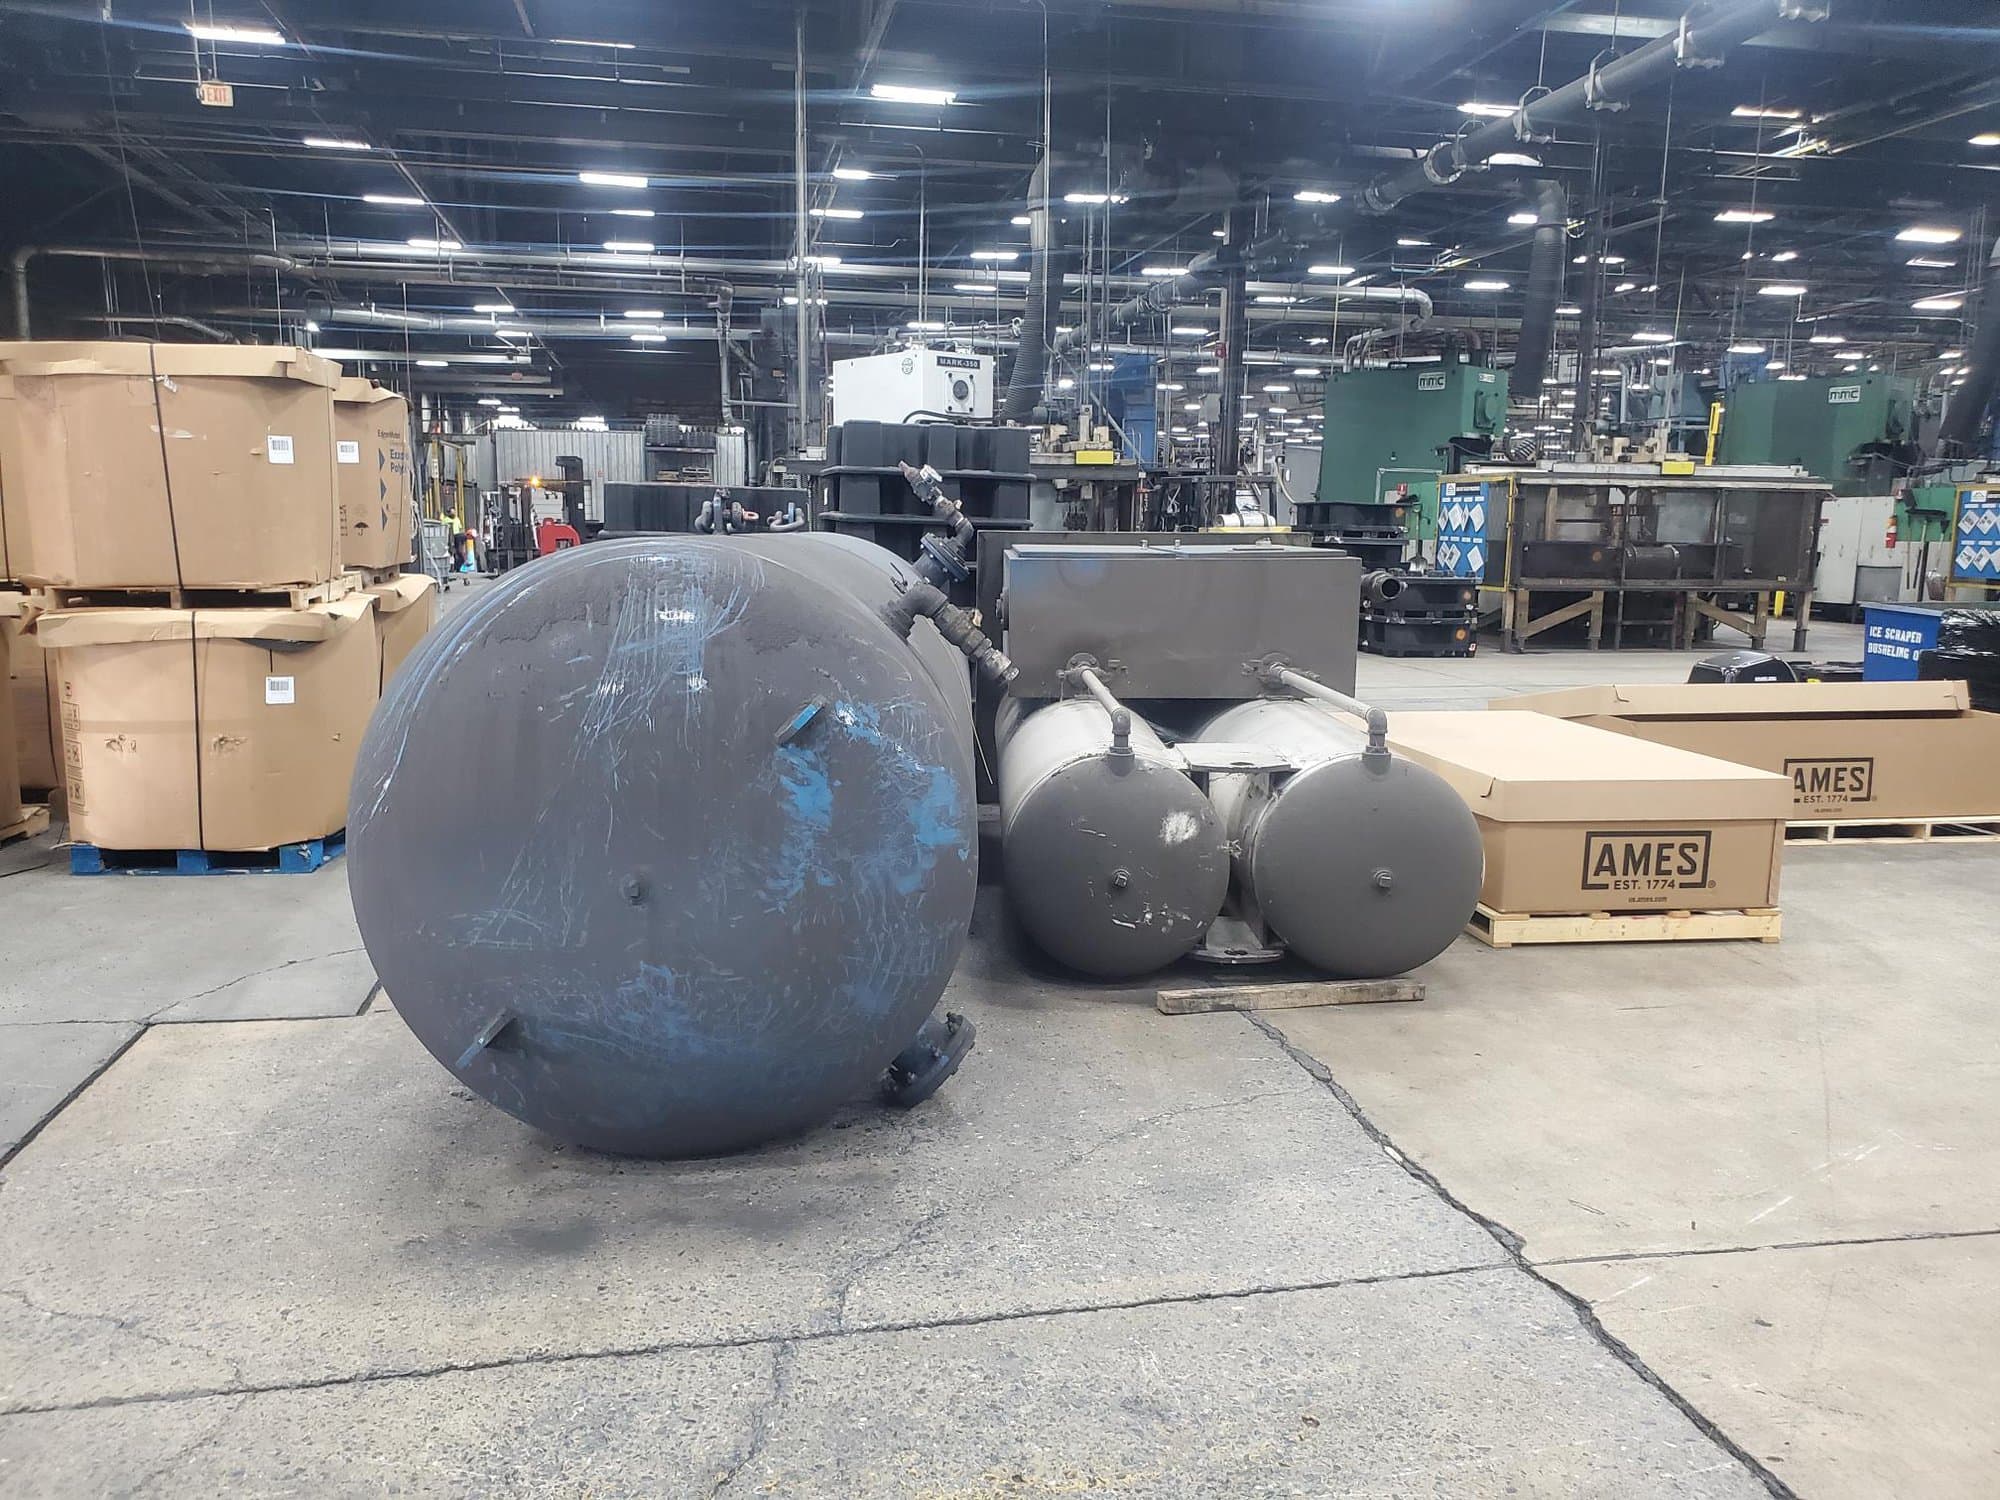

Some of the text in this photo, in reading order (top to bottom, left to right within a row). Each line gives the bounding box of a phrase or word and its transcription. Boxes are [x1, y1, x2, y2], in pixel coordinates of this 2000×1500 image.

[207, 87, 227, 101] EXIT
[940, 358, 978, 367] MARK-350
[1869, 626, 1922, 643] ICE SCRAPER
[1867, 643, 1910, 659] BUSHELING
[1794, 767, 1865, 792] AMES
[1803, 795, 1848, 803] EST. 1774
[1593, 843, 1699, 876] AMES
[1614, 879, 1676, 890] EST. 1774
